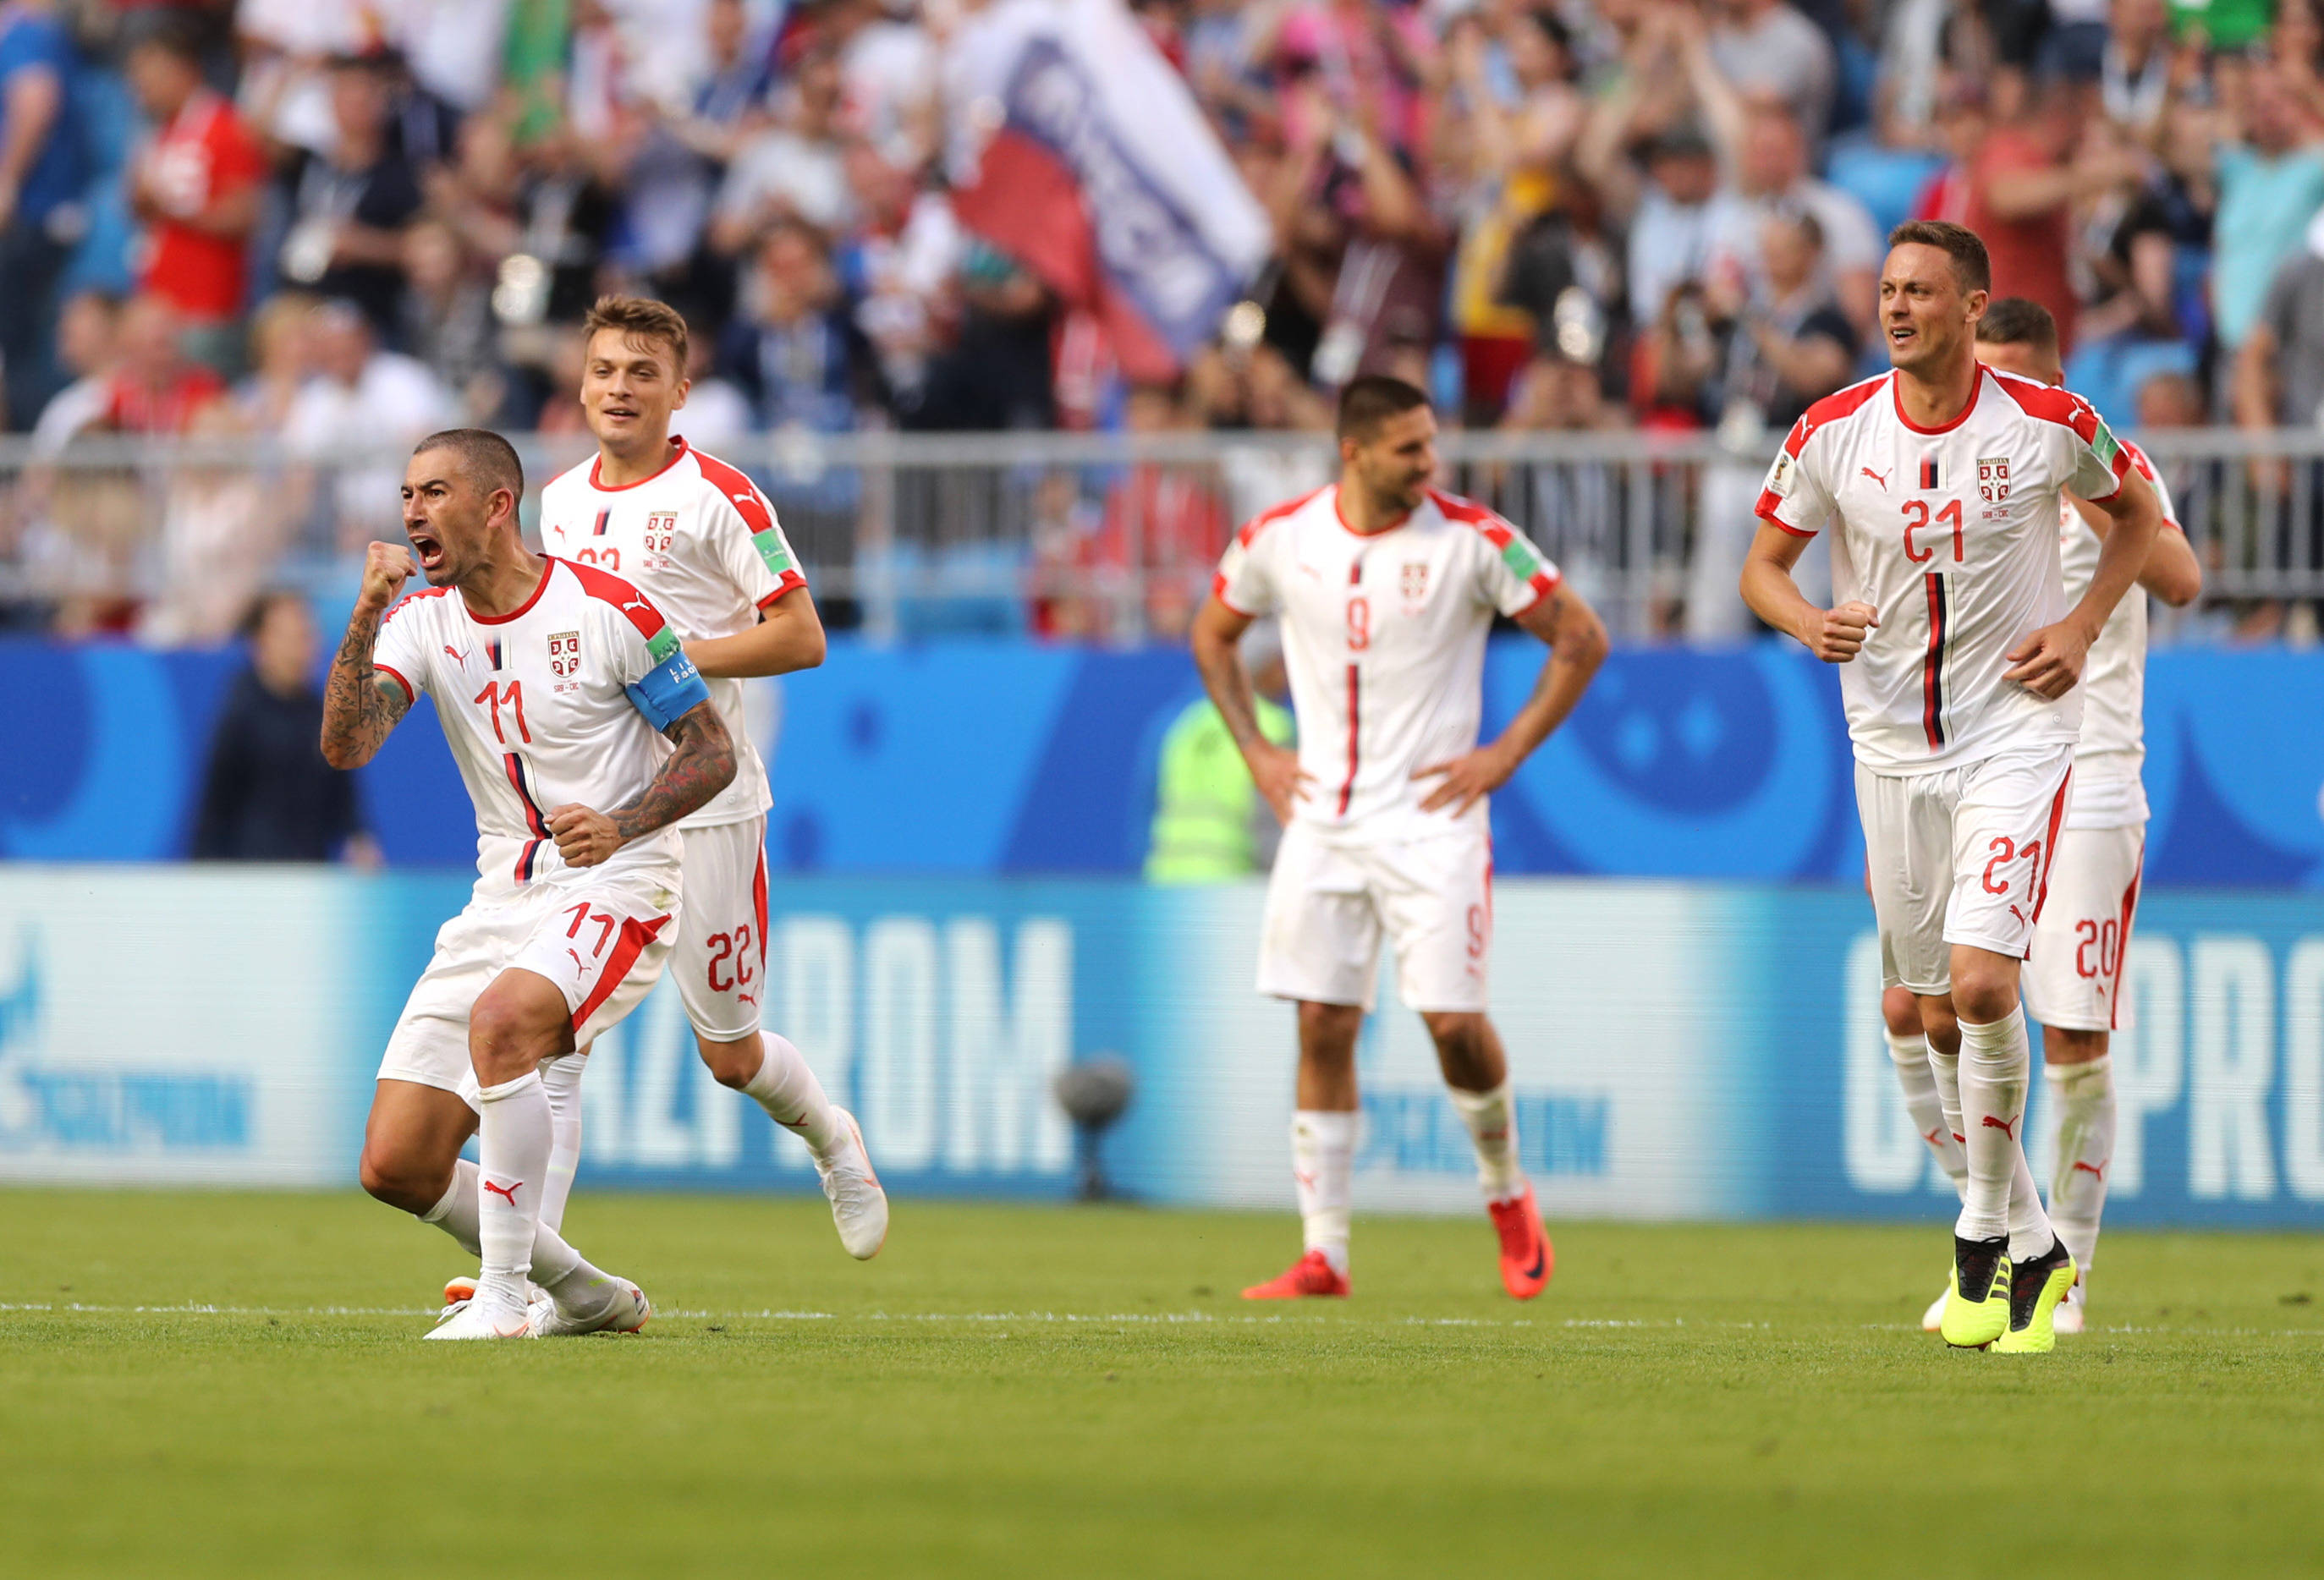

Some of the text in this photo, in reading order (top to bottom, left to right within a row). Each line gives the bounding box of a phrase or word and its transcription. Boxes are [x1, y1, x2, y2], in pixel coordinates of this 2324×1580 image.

[1901, 499, 1964, 562] 21
[1347, 596, 1370, 652] 9
[475, 680, 532, 744] 11
[1982, 836, 2041, 903] 21
[562, 902, 616, 958] 11
[706, 923, 753, 991] 22
[1467, 902, 1486, 958] 9
[2075, 919, 2117, 978] 20
